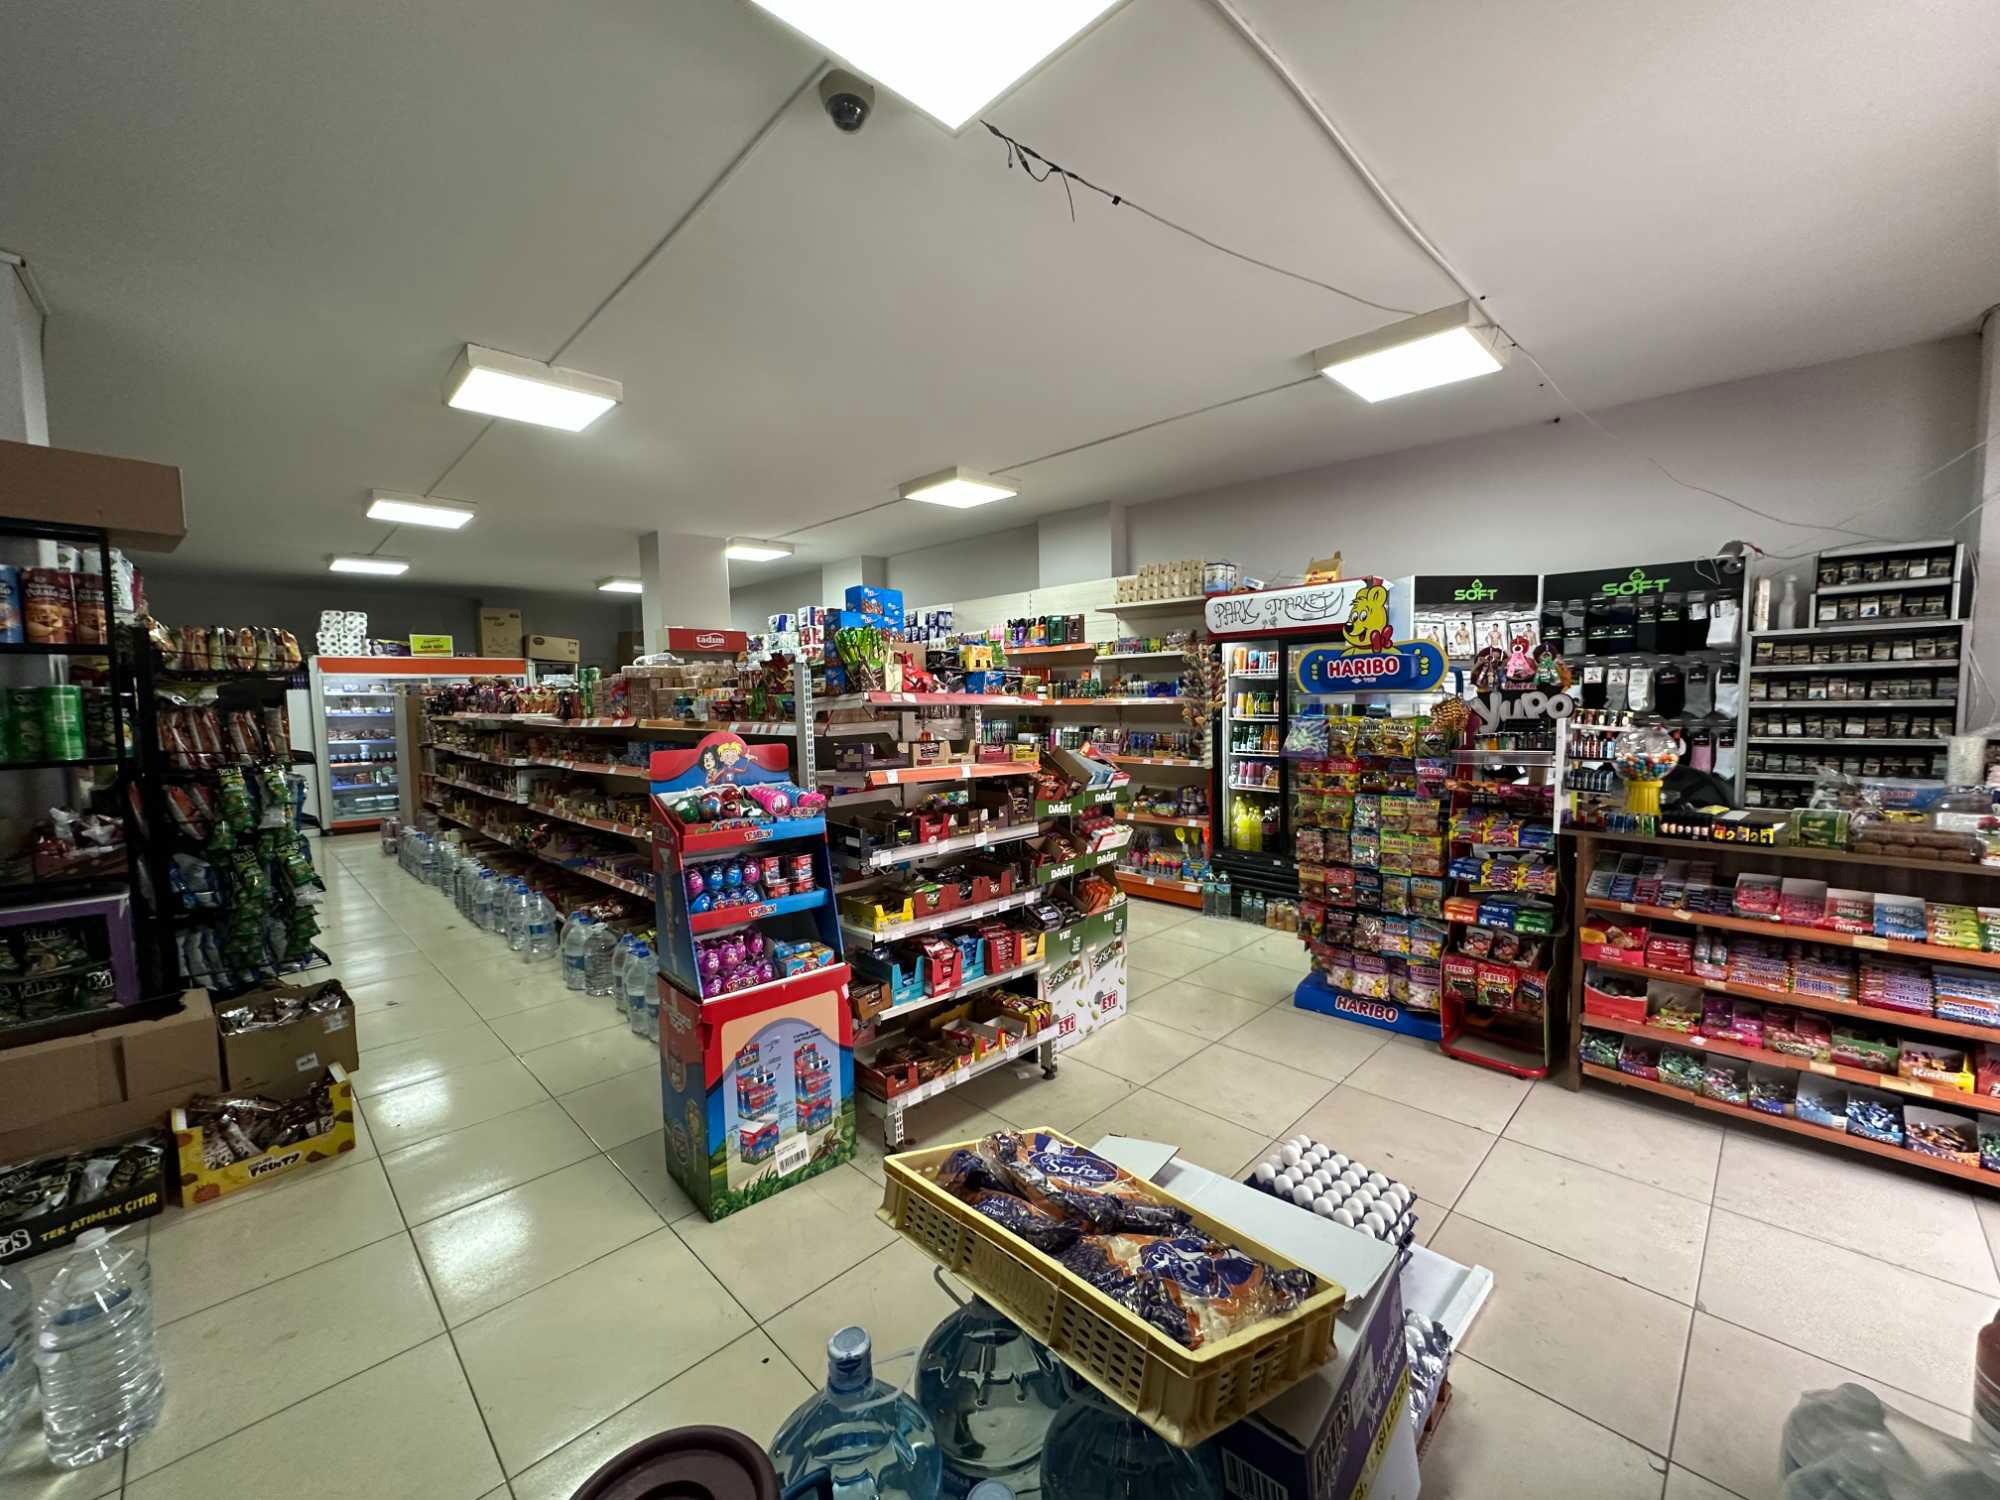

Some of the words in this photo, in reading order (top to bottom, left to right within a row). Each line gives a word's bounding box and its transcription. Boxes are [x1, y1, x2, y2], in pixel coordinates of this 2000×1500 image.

[1454, 588, 1499, 601] SOFT
[1602, 578, 1671, 596] SOFT
[1214, 598, 1260, 629] PARK
[1265, 588, 1344, 621] MARKET
[1327, 655, 1400, 679] HARIBO
[1095, 790, 1117, 802] DAĞIT
[1048, 801, 1072, 814] DAĞIT
[1097, 851, 1118, 864] DAĞIT
[1051, 863, 1075, 879] DAĞIT
[1335, 995, 1399, 1023] HARIBO
[1046, 1159, 1099, 1176] Safa
[40, 1225, 66, 1242] TEK
[70, 1204, 122, 1231] ATIMLIK
[124, 1192, 158, 1214] ÇITIR
